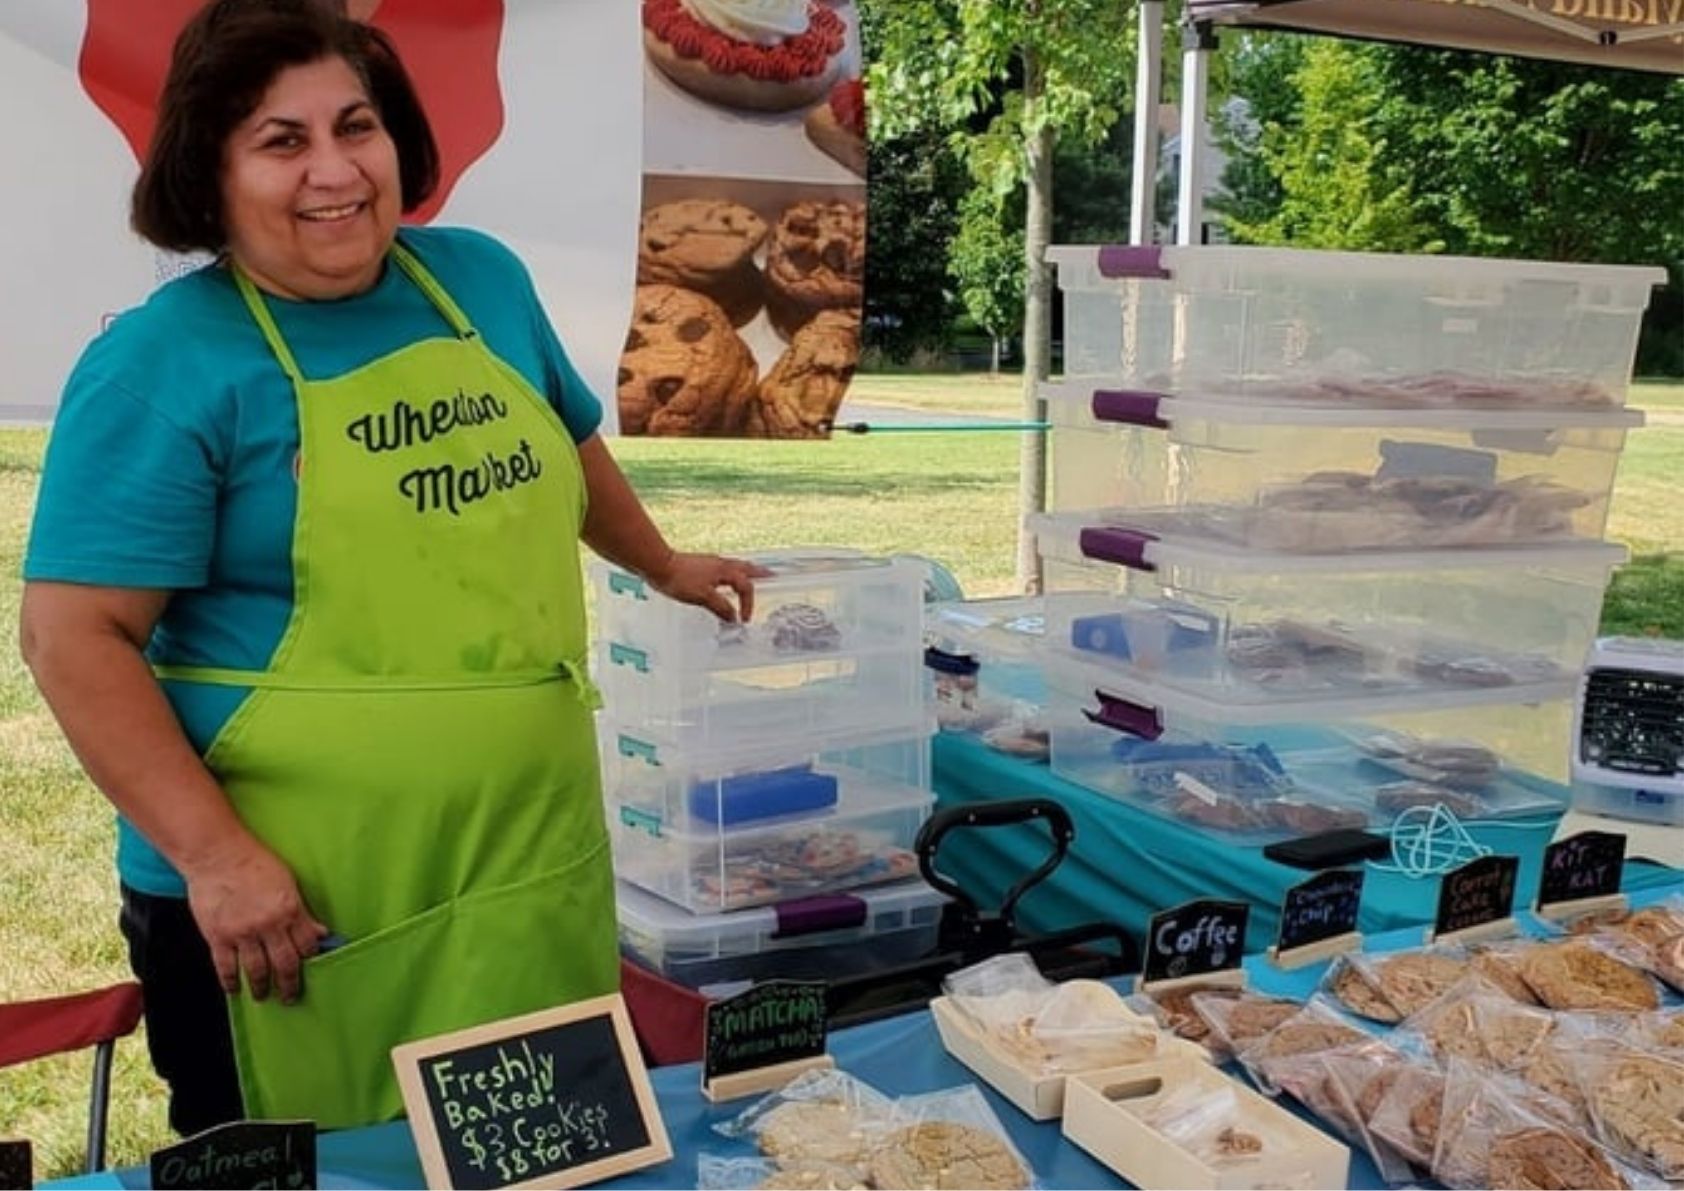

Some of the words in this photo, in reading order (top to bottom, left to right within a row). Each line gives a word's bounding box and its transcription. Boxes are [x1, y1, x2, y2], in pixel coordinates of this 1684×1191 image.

[346, 388, 508, 453] Wheton
[1155, 915, 1238, 954] Coffee
[725, 997, 817, 1039] MATCHA
[432, 1039, 554, 1098] Freshly
[512, 1102, 608, 1147] Cookies
[160, 1132, 293, 1185] Oatmeal
[531, 1139, 573, 1167] for
